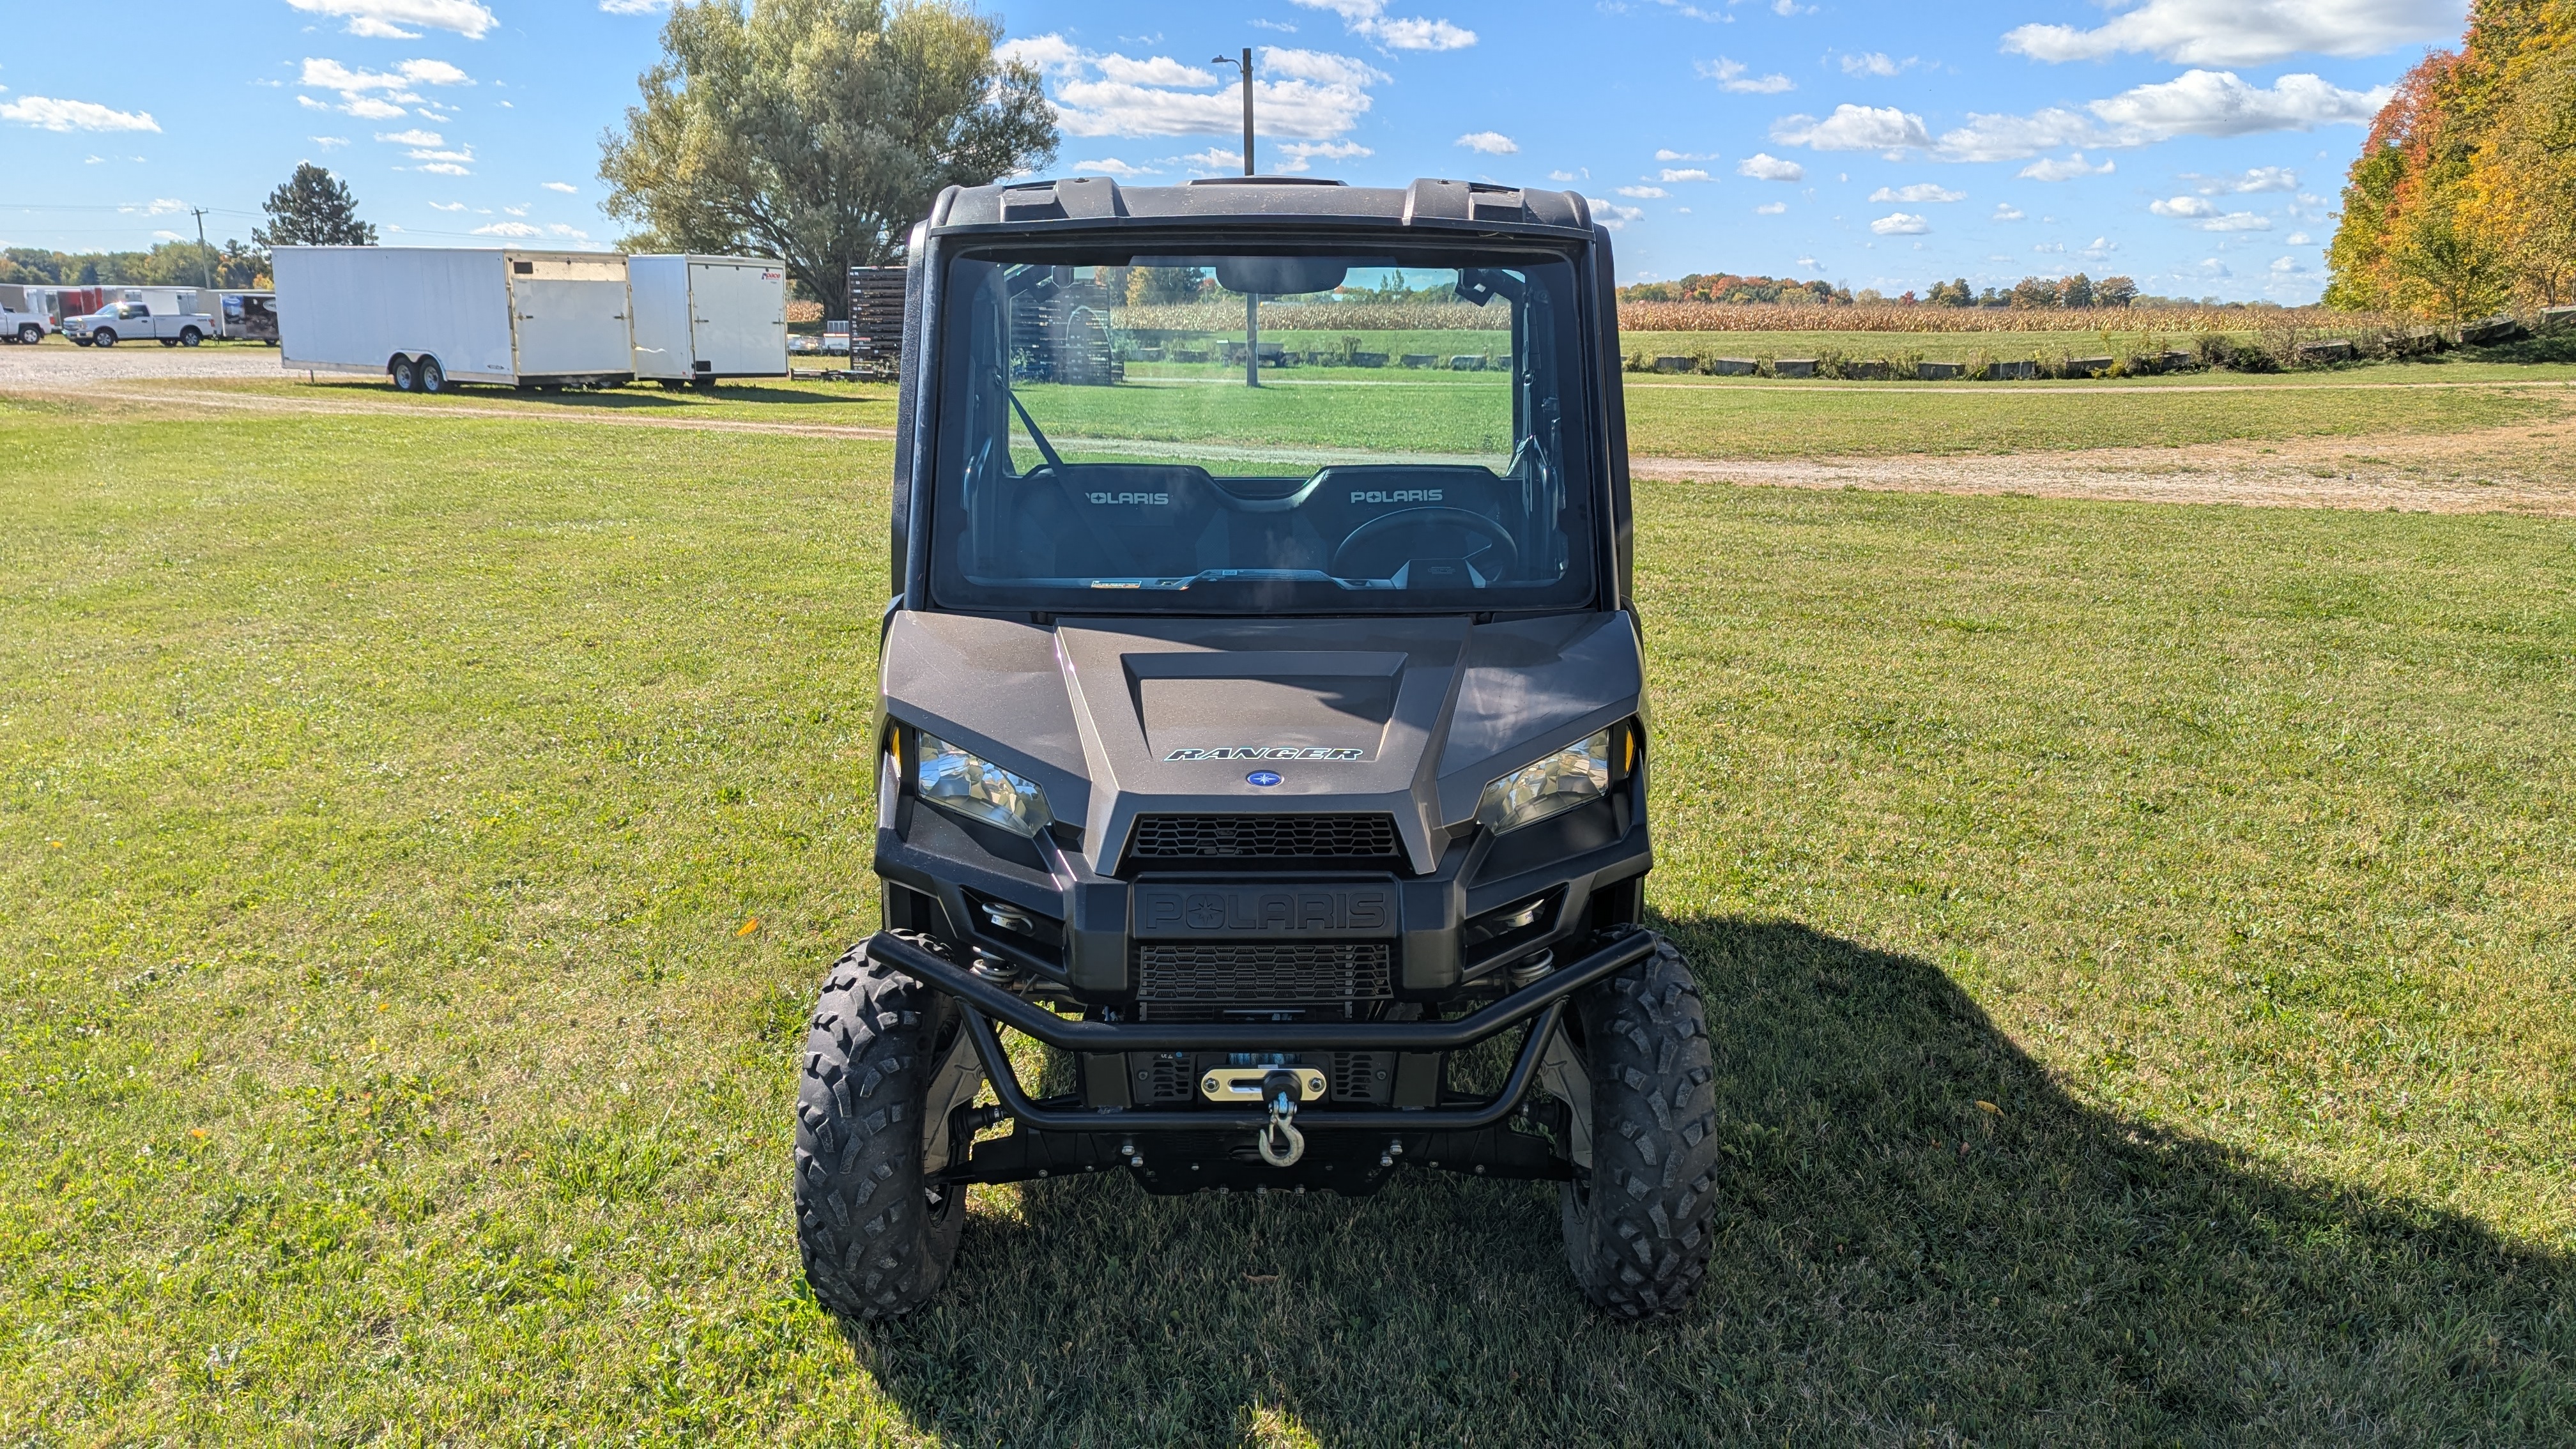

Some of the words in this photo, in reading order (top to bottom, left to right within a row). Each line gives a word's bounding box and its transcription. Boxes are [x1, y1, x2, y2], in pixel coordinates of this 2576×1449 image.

[1085, 492, 1169, 505] OLARIS
[1351, 489, 1443, 503] POLARIS
[1163, 747, 1363, 762] RANGER
[1146, 893, 1386, 930] POLARIS
